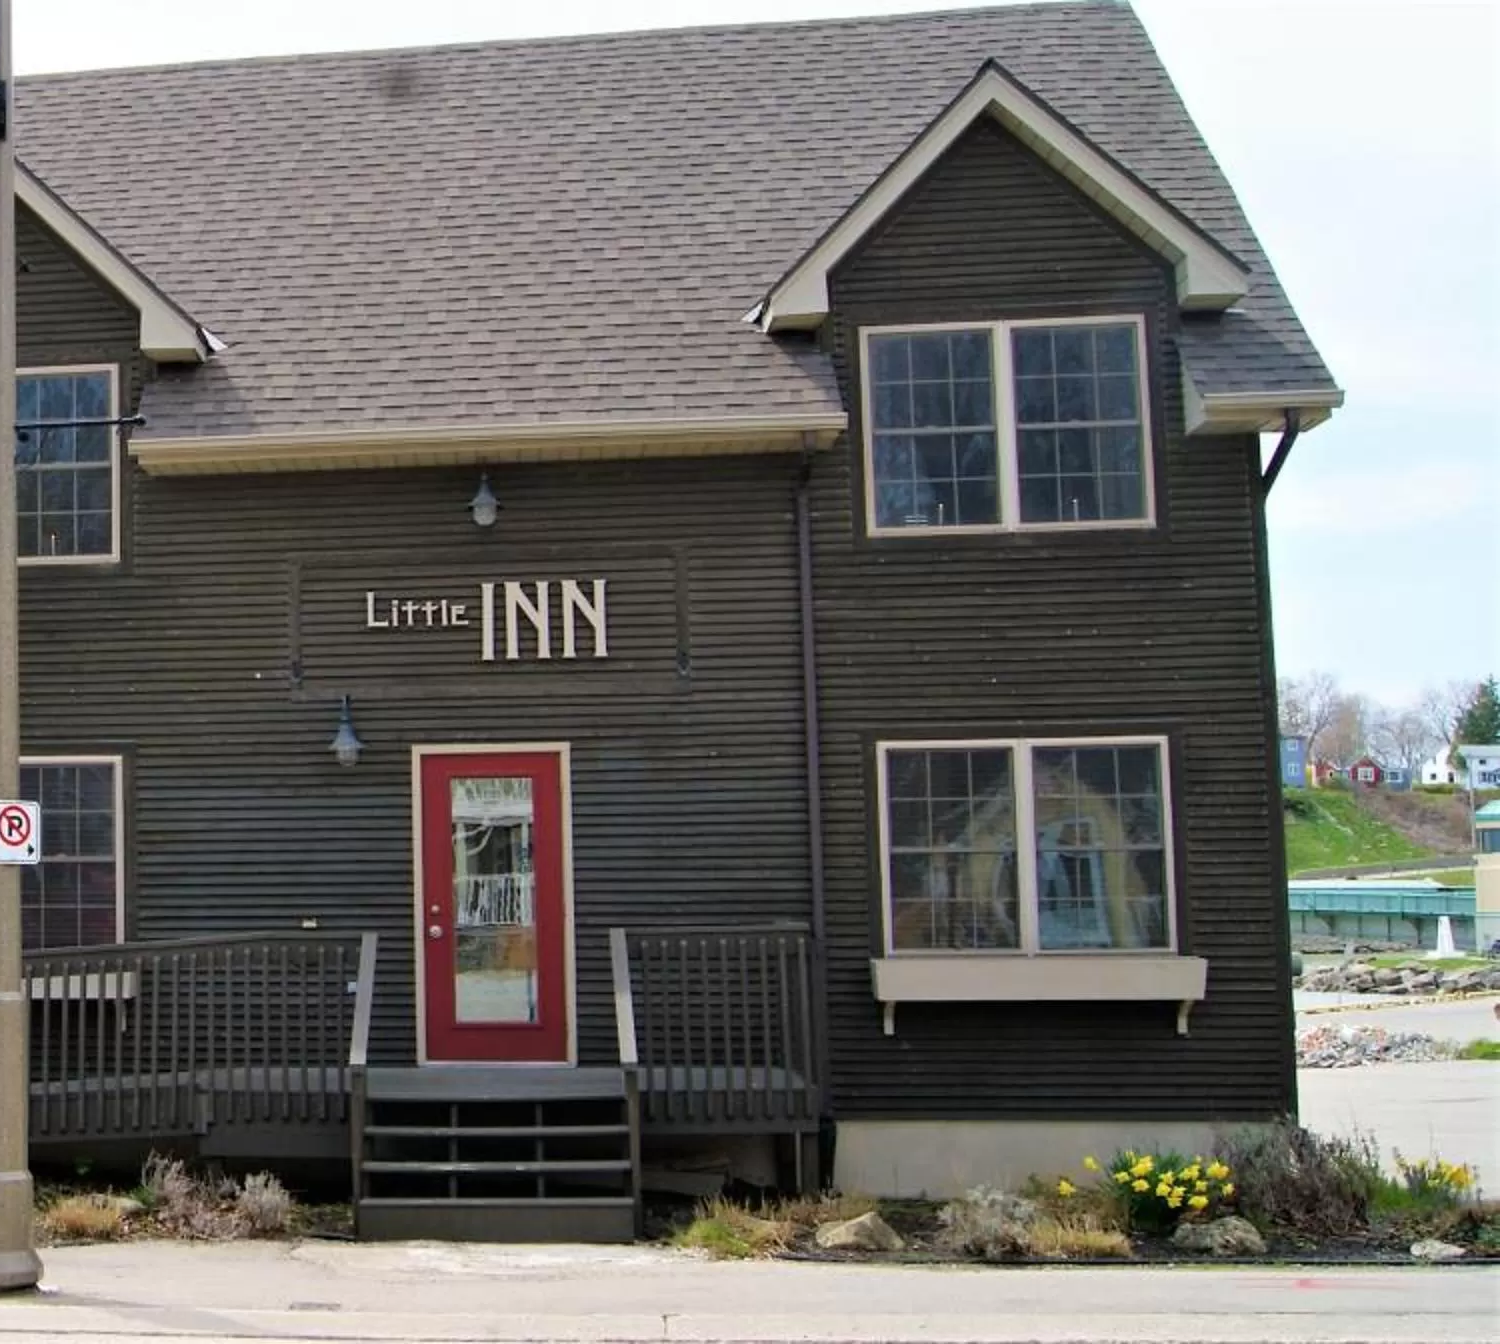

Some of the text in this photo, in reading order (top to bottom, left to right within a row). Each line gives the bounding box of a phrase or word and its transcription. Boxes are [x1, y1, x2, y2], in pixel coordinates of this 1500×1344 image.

[366, 579, 608, 660] Little INN
[7, 815, 23, 837] P
